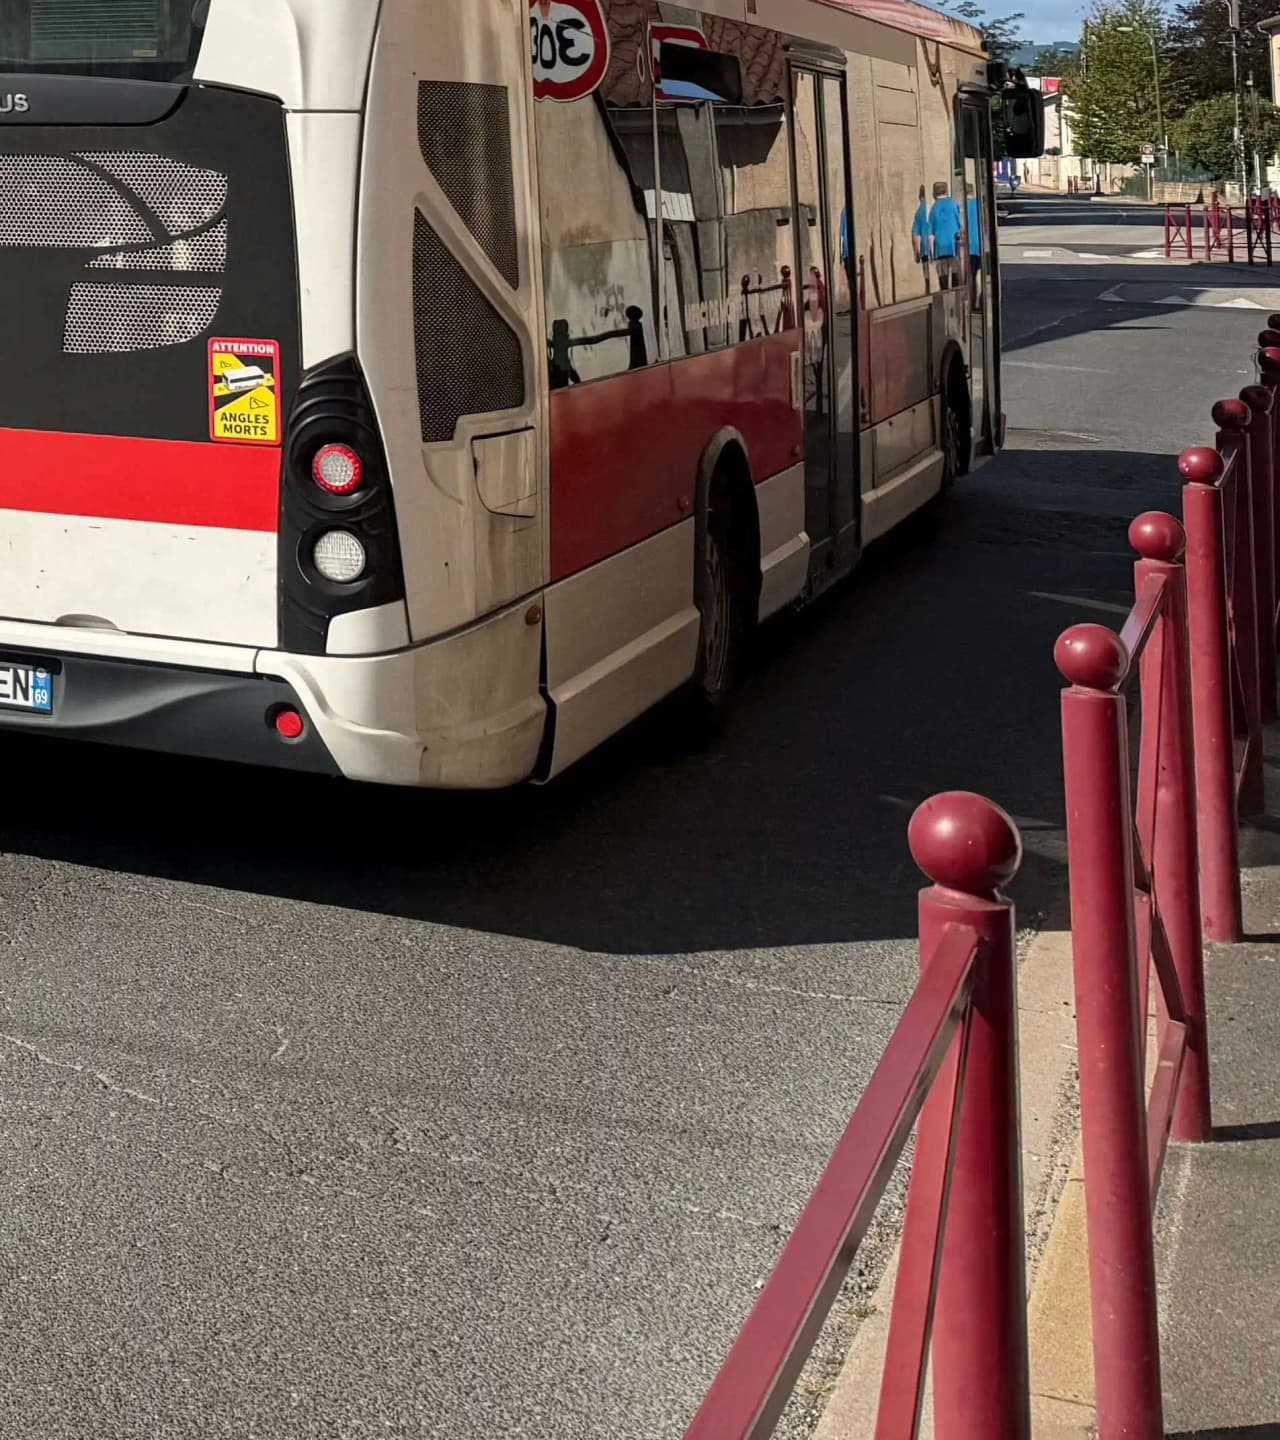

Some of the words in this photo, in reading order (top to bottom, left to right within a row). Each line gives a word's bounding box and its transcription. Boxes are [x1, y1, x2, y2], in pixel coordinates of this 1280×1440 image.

[212, 342, 274, 353] ATTENTION
[220, 412, 269, 424] ANGLES
[223, 423, 267, 435] MORTS
[34, 689, 48, 704] 69
